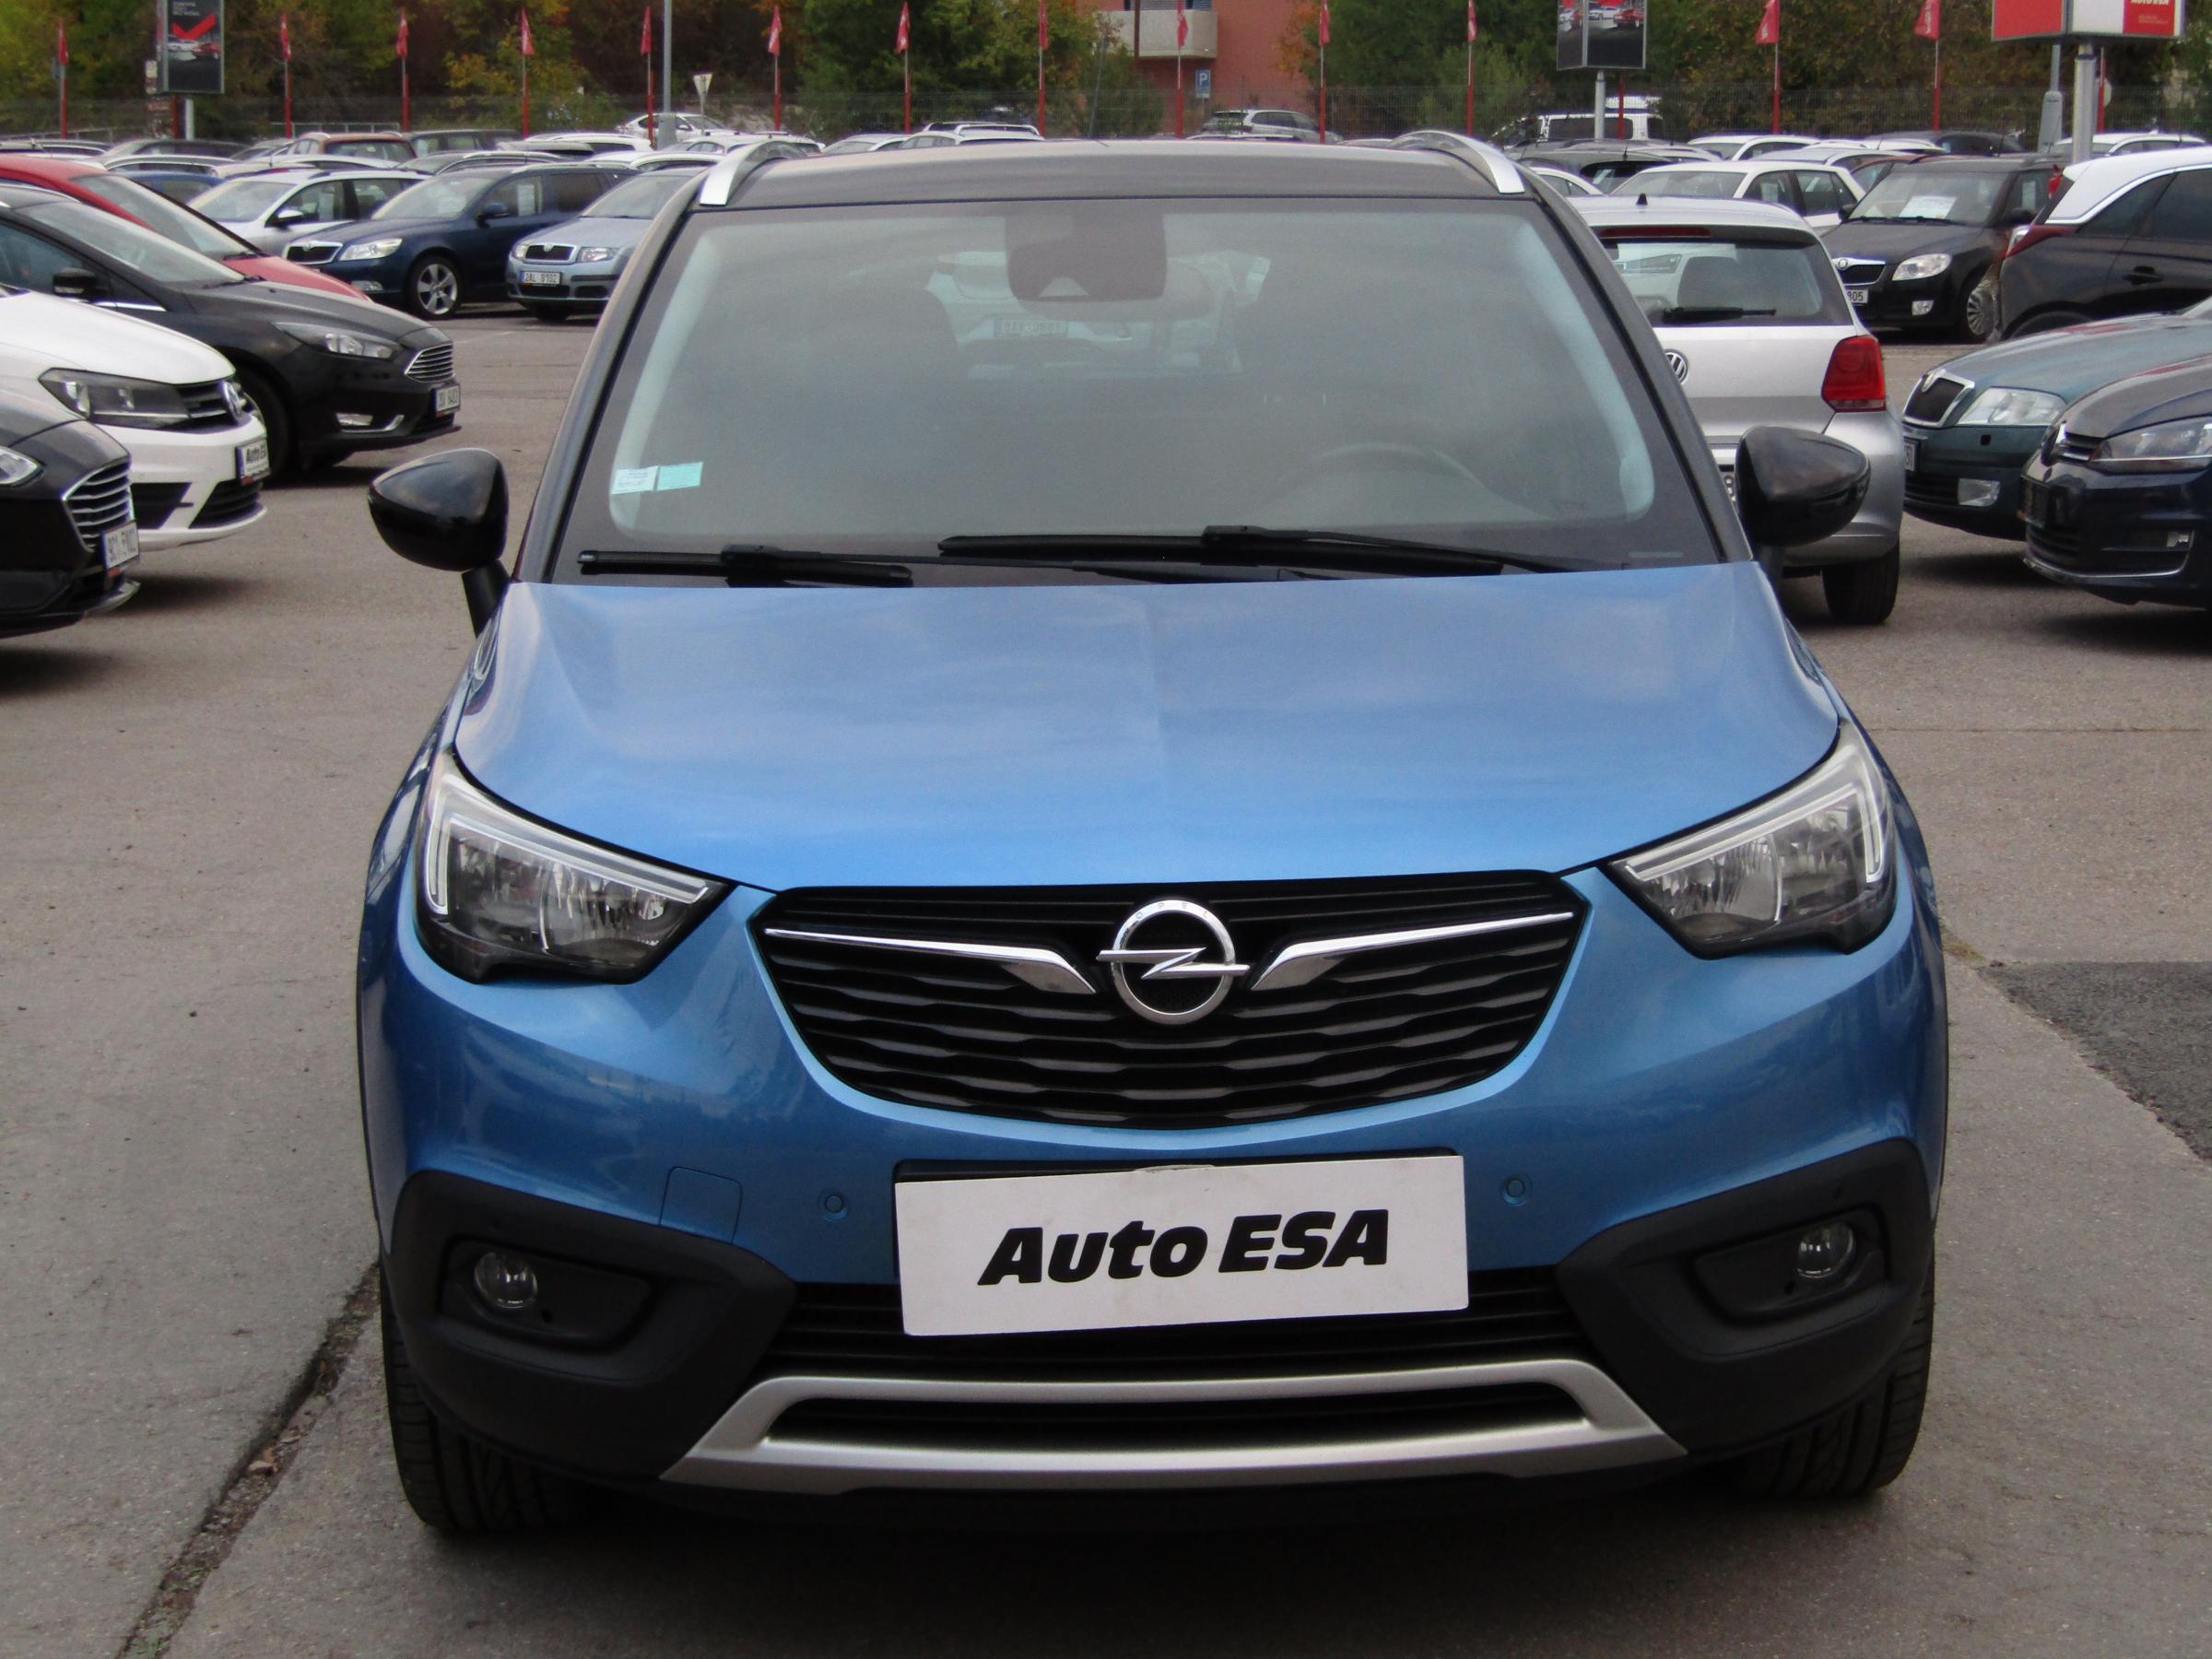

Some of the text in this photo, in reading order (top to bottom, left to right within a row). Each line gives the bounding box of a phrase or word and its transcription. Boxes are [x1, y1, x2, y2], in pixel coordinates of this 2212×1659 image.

[1199, 73, 1208, 88] P
[1135, 902, 1210, 919] OPEL
[977, 1208, 1389, 1286] Auto ESA
